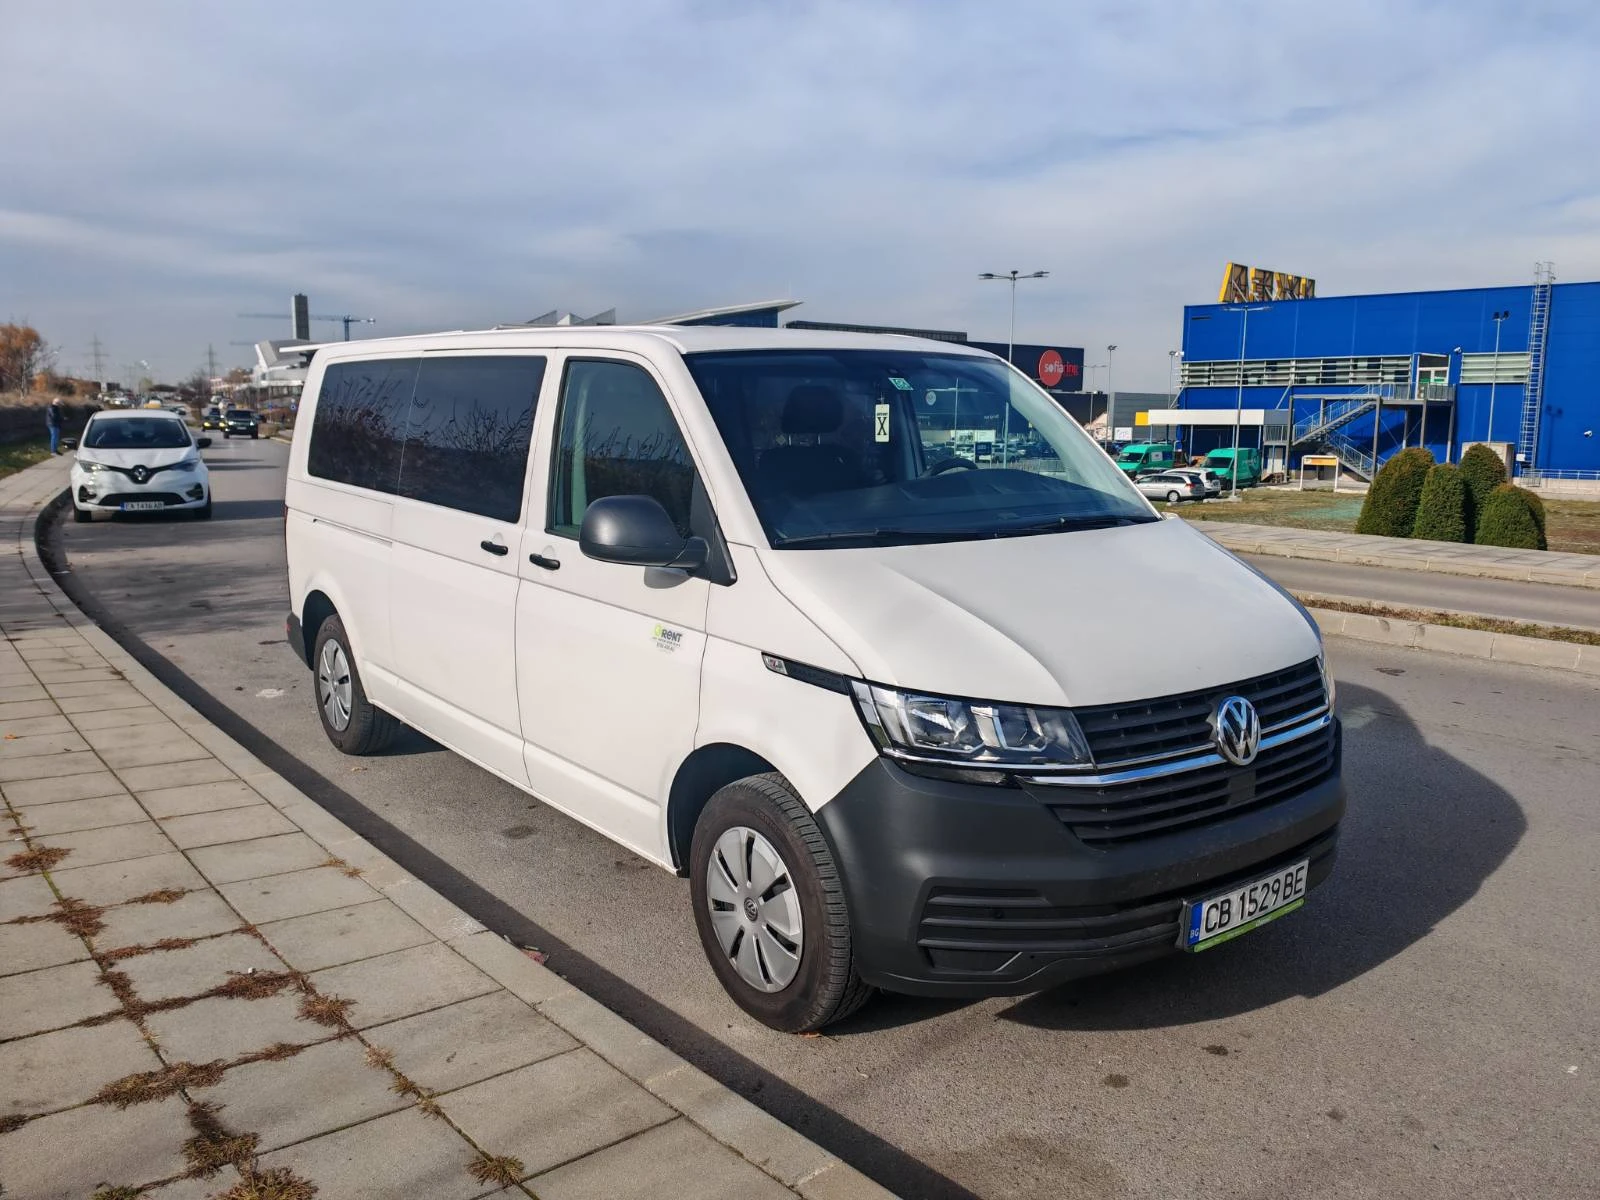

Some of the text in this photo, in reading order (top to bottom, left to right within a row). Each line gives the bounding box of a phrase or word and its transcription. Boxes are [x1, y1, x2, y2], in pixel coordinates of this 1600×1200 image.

[1204, 865, 1306, 934] CB 1529 BE
[1190, 927, 1200, 938] BG
